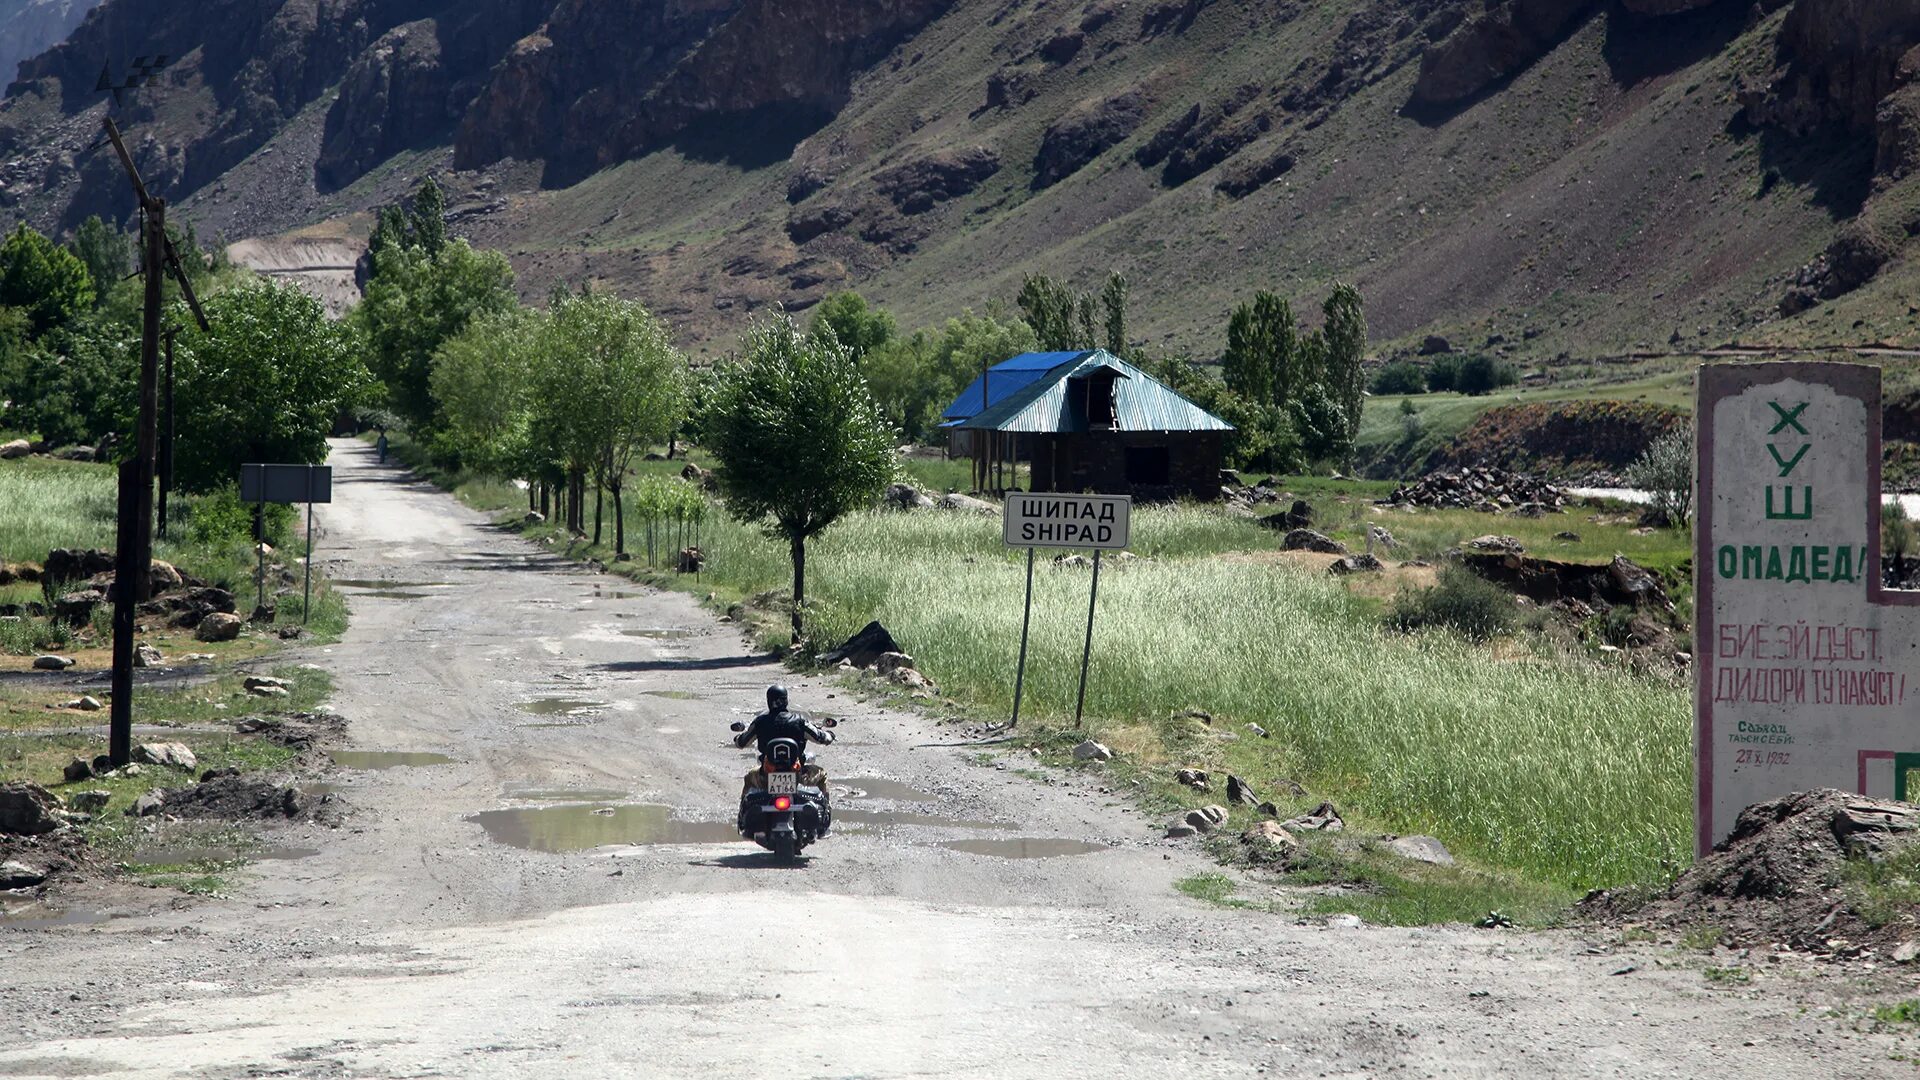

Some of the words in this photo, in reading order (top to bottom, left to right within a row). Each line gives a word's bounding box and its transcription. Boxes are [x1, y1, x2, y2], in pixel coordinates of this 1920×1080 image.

[1766, 402, 1812, 519] ХУШ
[1022, 500, 1115, 523] ШИПАД
[1022, 523, 1112, 542] SHIPAD
[1718, 545, 1867, 584] ОМАДЕД!
[1715, 667, 1805, 704] ДИДОРИ
[1811, 670, 1834, 704] ТУ
[772, 774, 791, 782] 7111
